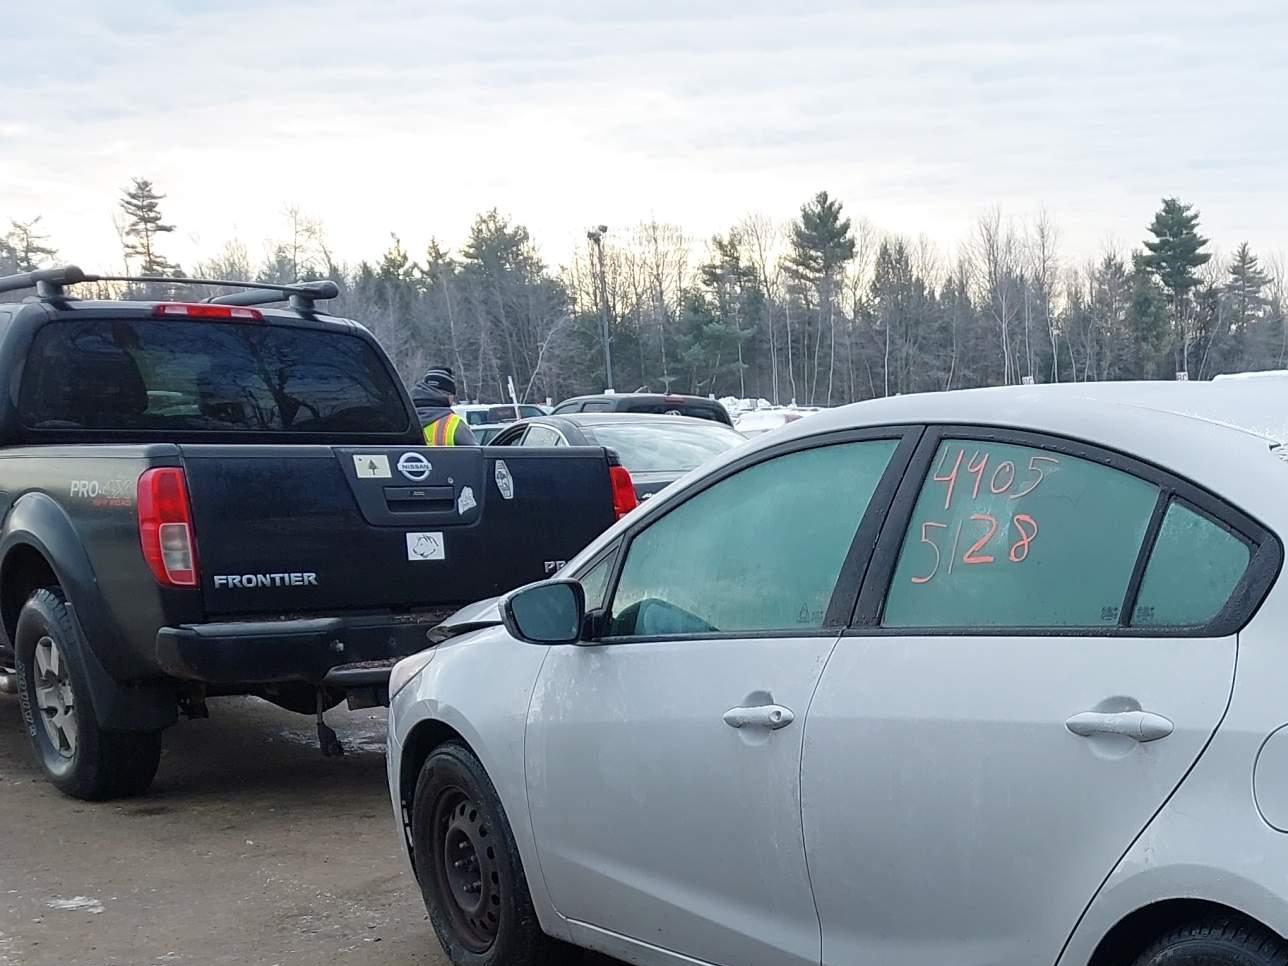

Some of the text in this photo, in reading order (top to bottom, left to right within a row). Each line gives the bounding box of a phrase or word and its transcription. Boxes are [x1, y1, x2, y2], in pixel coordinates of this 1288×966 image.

[933, 446, 1059, 510] 4405
[213, 572, 318, 589] FRONTIER
[911, 514, 1038, 583] 5128
